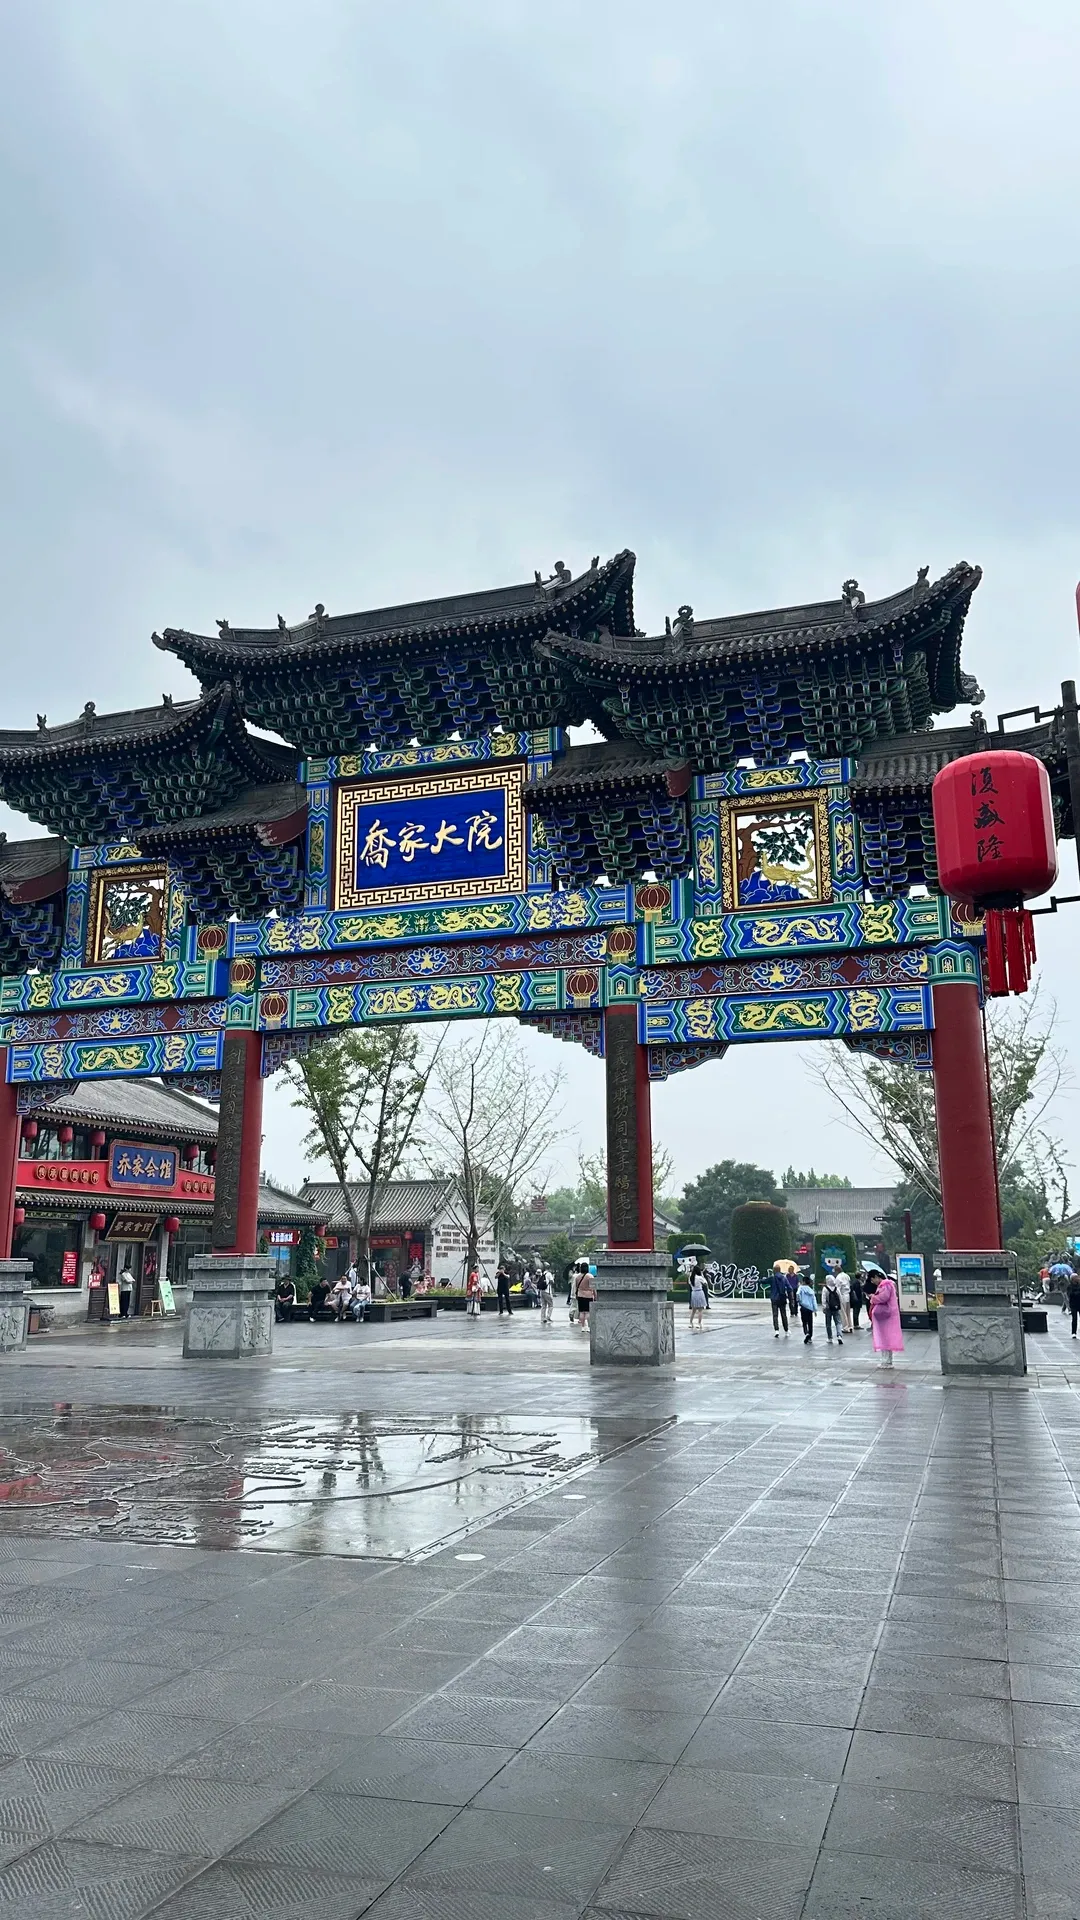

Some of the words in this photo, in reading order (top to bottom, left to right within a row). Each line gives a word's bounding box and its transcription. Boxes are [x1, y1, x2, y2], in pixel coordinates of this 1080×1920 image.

[360, 810, 503, 869] 喬家大院
[116, 1152, 172, 1180] 乔家会馆
